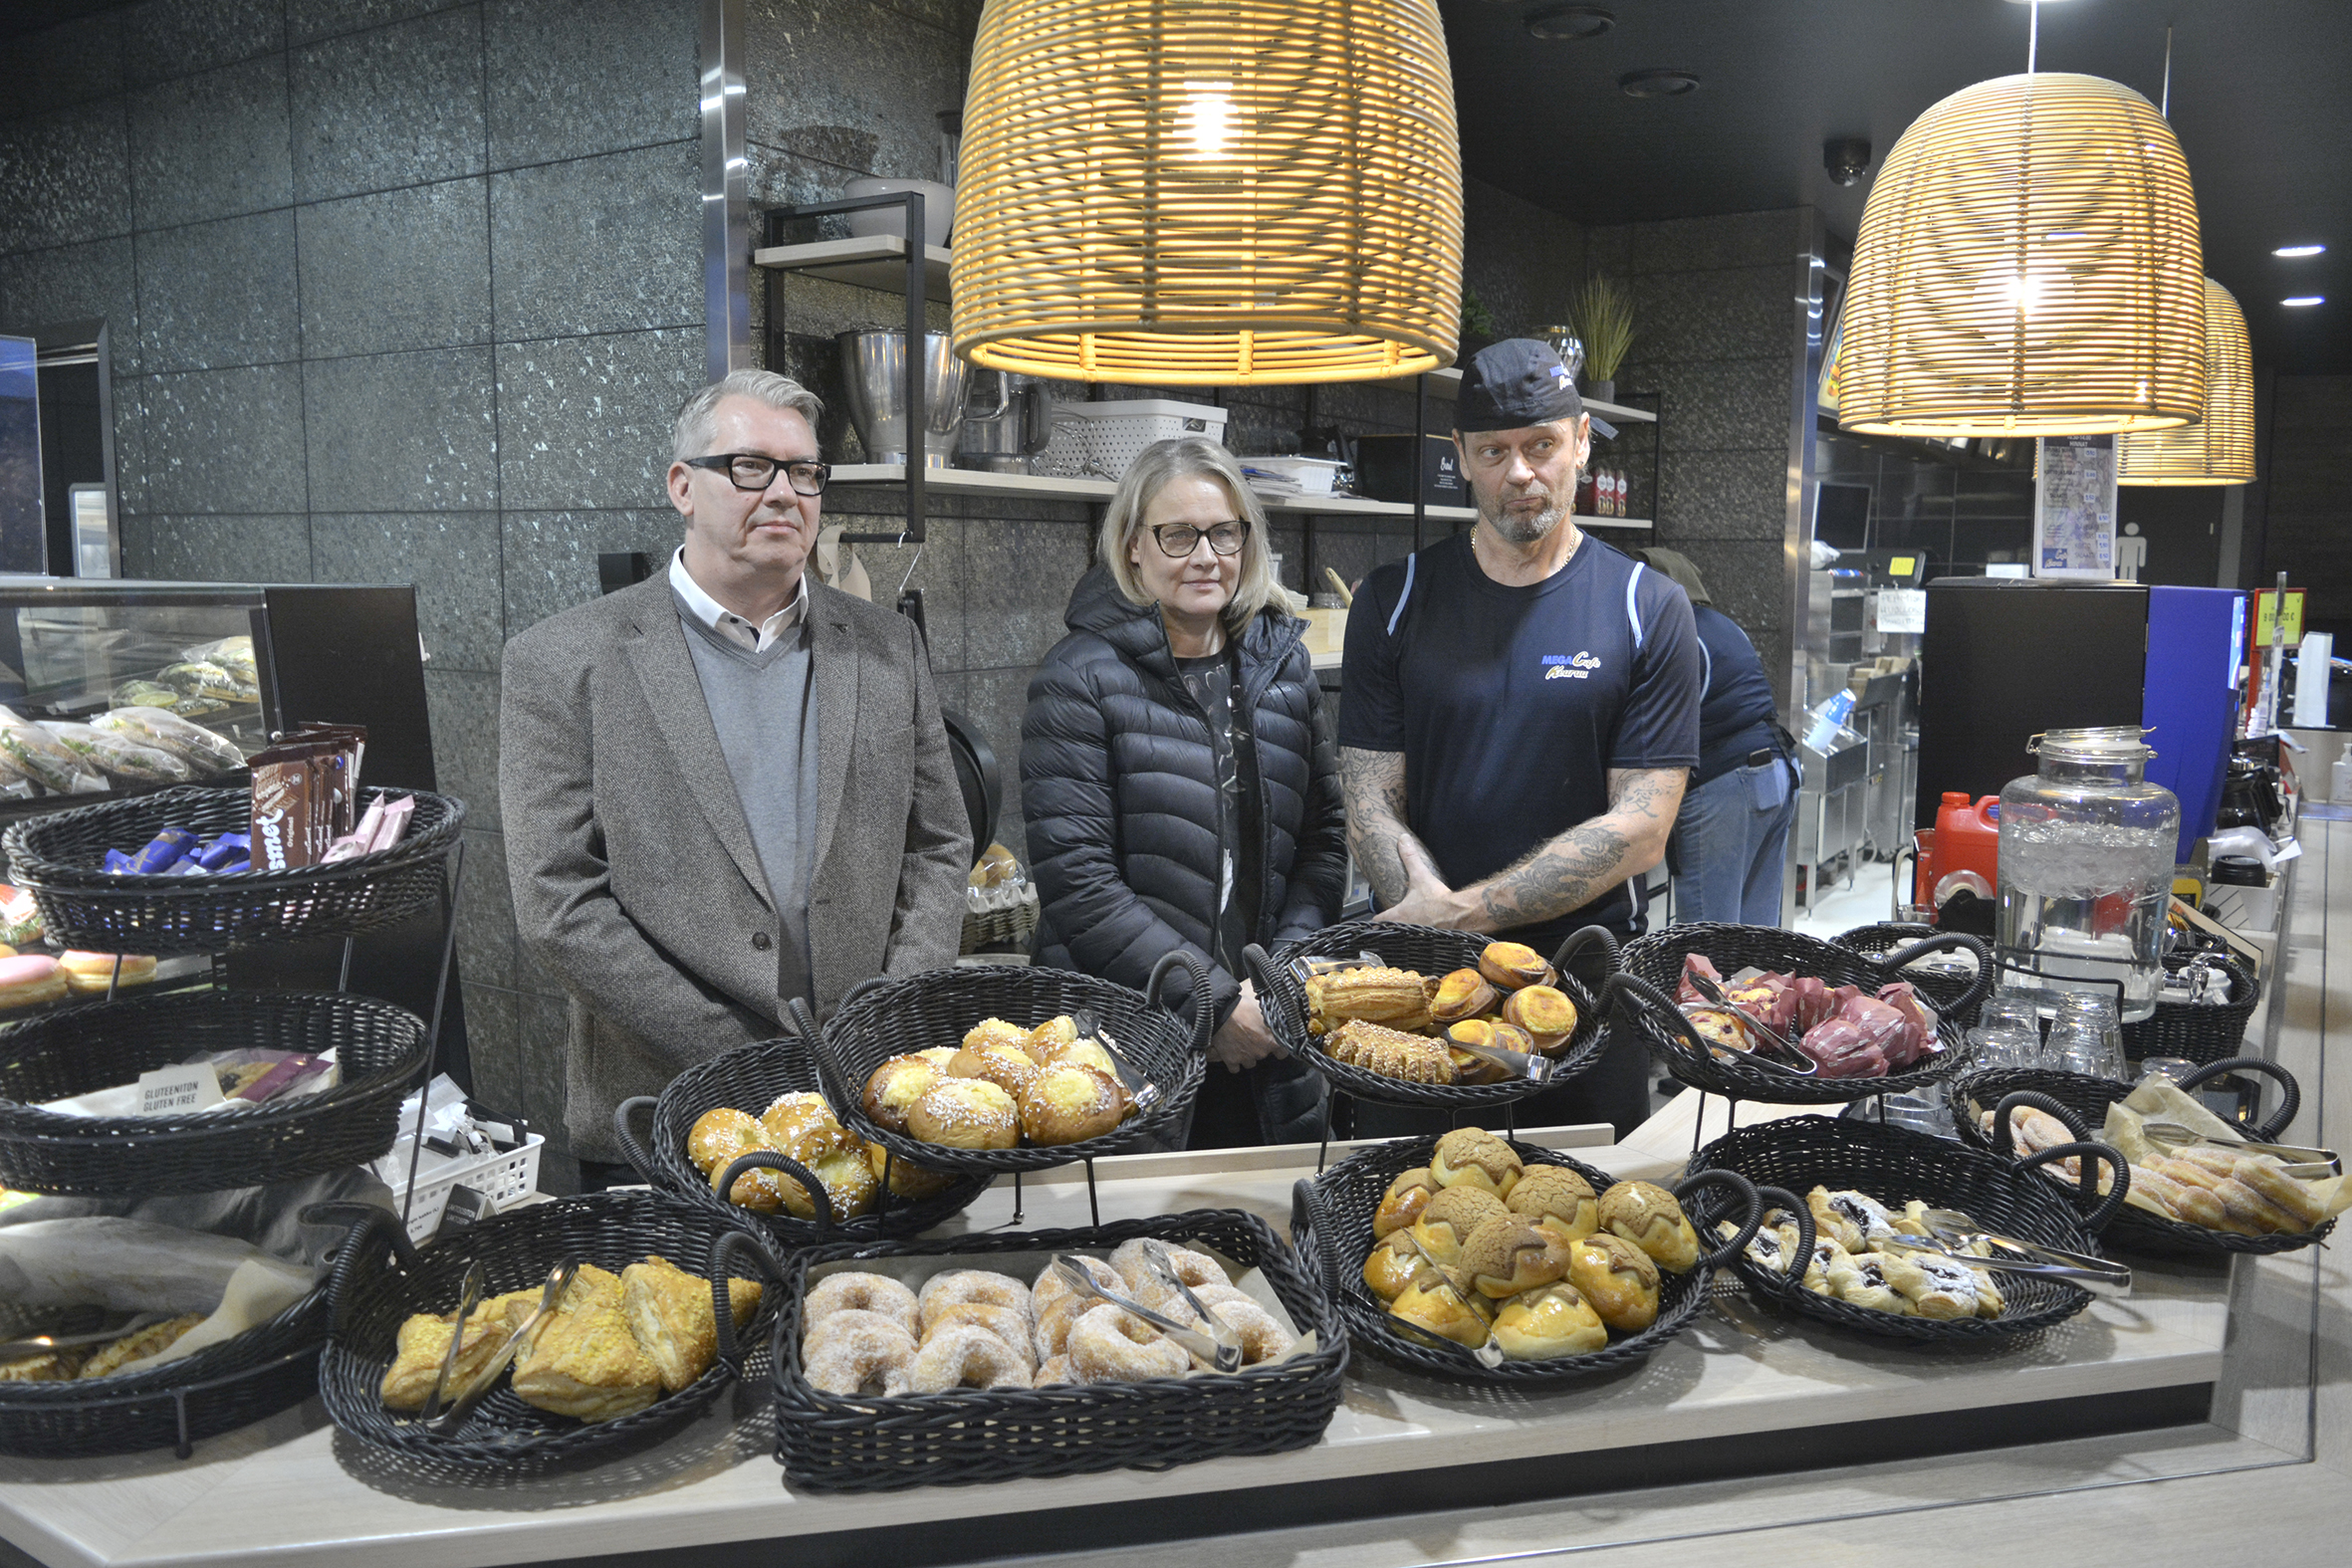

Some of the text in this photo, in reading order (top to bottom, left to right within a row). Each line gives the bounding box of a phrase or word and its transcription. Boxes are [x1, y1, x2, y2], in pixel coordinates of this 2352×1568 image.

[1545, 665, 1589, 680] Keuruu
[144, 1081, 199, 1100] GLUTEENITON
[143, 1093, 197, 1112] GLUTEN FREE
